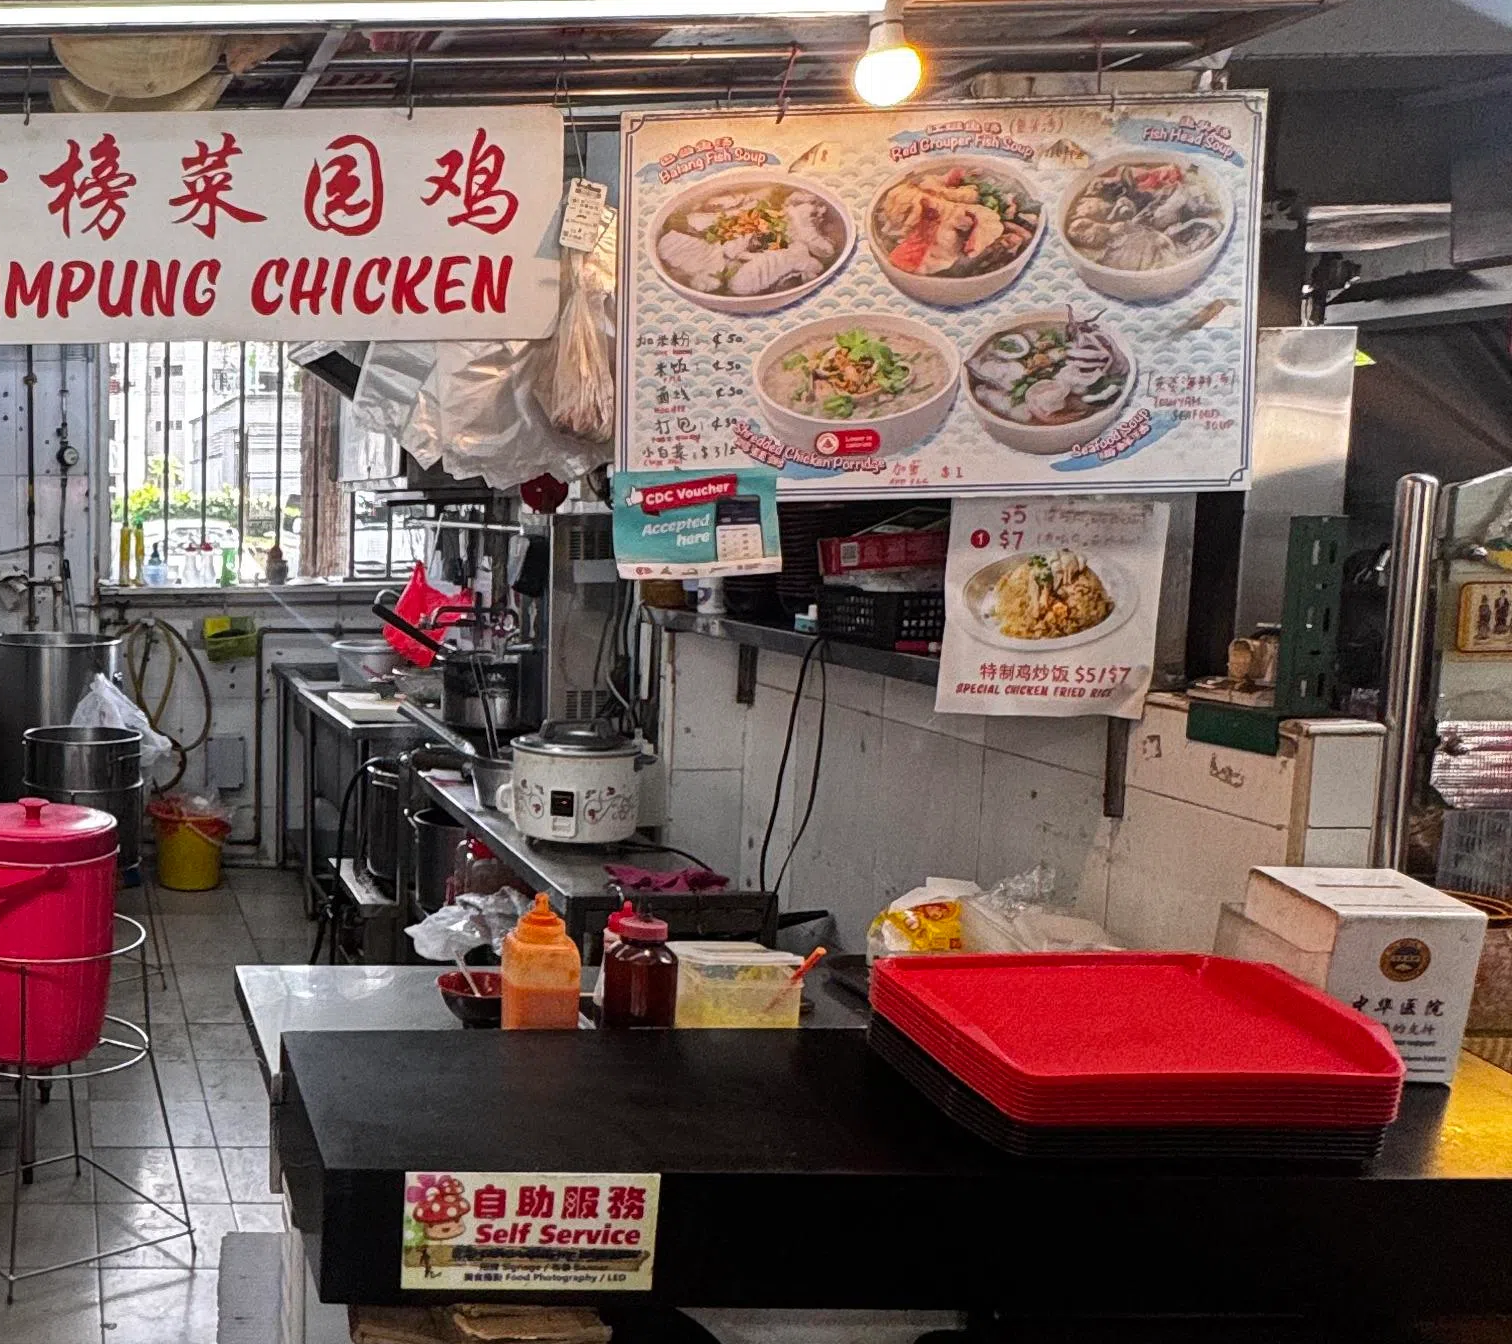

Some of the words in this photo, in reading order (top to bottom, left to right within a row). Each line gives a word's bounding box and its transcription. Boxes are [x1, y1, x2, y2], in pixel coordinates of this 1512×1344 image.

[890, 141, 918, 162] Red
[920, 135, 972, 152] Grouper
[975, 132, 1000, 149] Fish
[1002, 137, 1034, 159] Soup
[1143, 127, 1167, 142] Fish
[1170, 128, 1203, 147] Head
[1205, 135, 1235, 160] Soup
[659, 158, 705, 184] Batang
[706, 148, 733, 165] Fish
[735, 147, 768, 167] Soup
[251, 255, 514, 316] CHICKEN
[1071, 430, 1122, 458] Seafood
[1119, 408, 1153, 434] Soup
[734, 420, 785, 457] Shredded
[784, 446, 832, 470] Chicken
[832, 456, 887, 475] Porridge
[645, 490, 675, 506] CDC
[676, 482, 731, 500] Voucher
[642, 513, 711, 537] Accepted
[999, 529, 1025, 551] $7
[979, 663, 1070, 682] 特制鸡炒饭
[1075, 666, 1132, 685] $5/$7
[955, 682, 1000, 696] SPECIAL
[1004, 684, 1049, 697] CHICKEN
[1053, 685, 1086, 698] FRIED
[1090, 687, 1116, 698] RICE
[473, 1184, 647, 1220] 自助服務
[474, 1223, 532, 1245] Self
[538, 1223, 641, 1245] Service
[506, 1273, 530, 1281] Food
[533, 1273, 597, 1283] Photography
